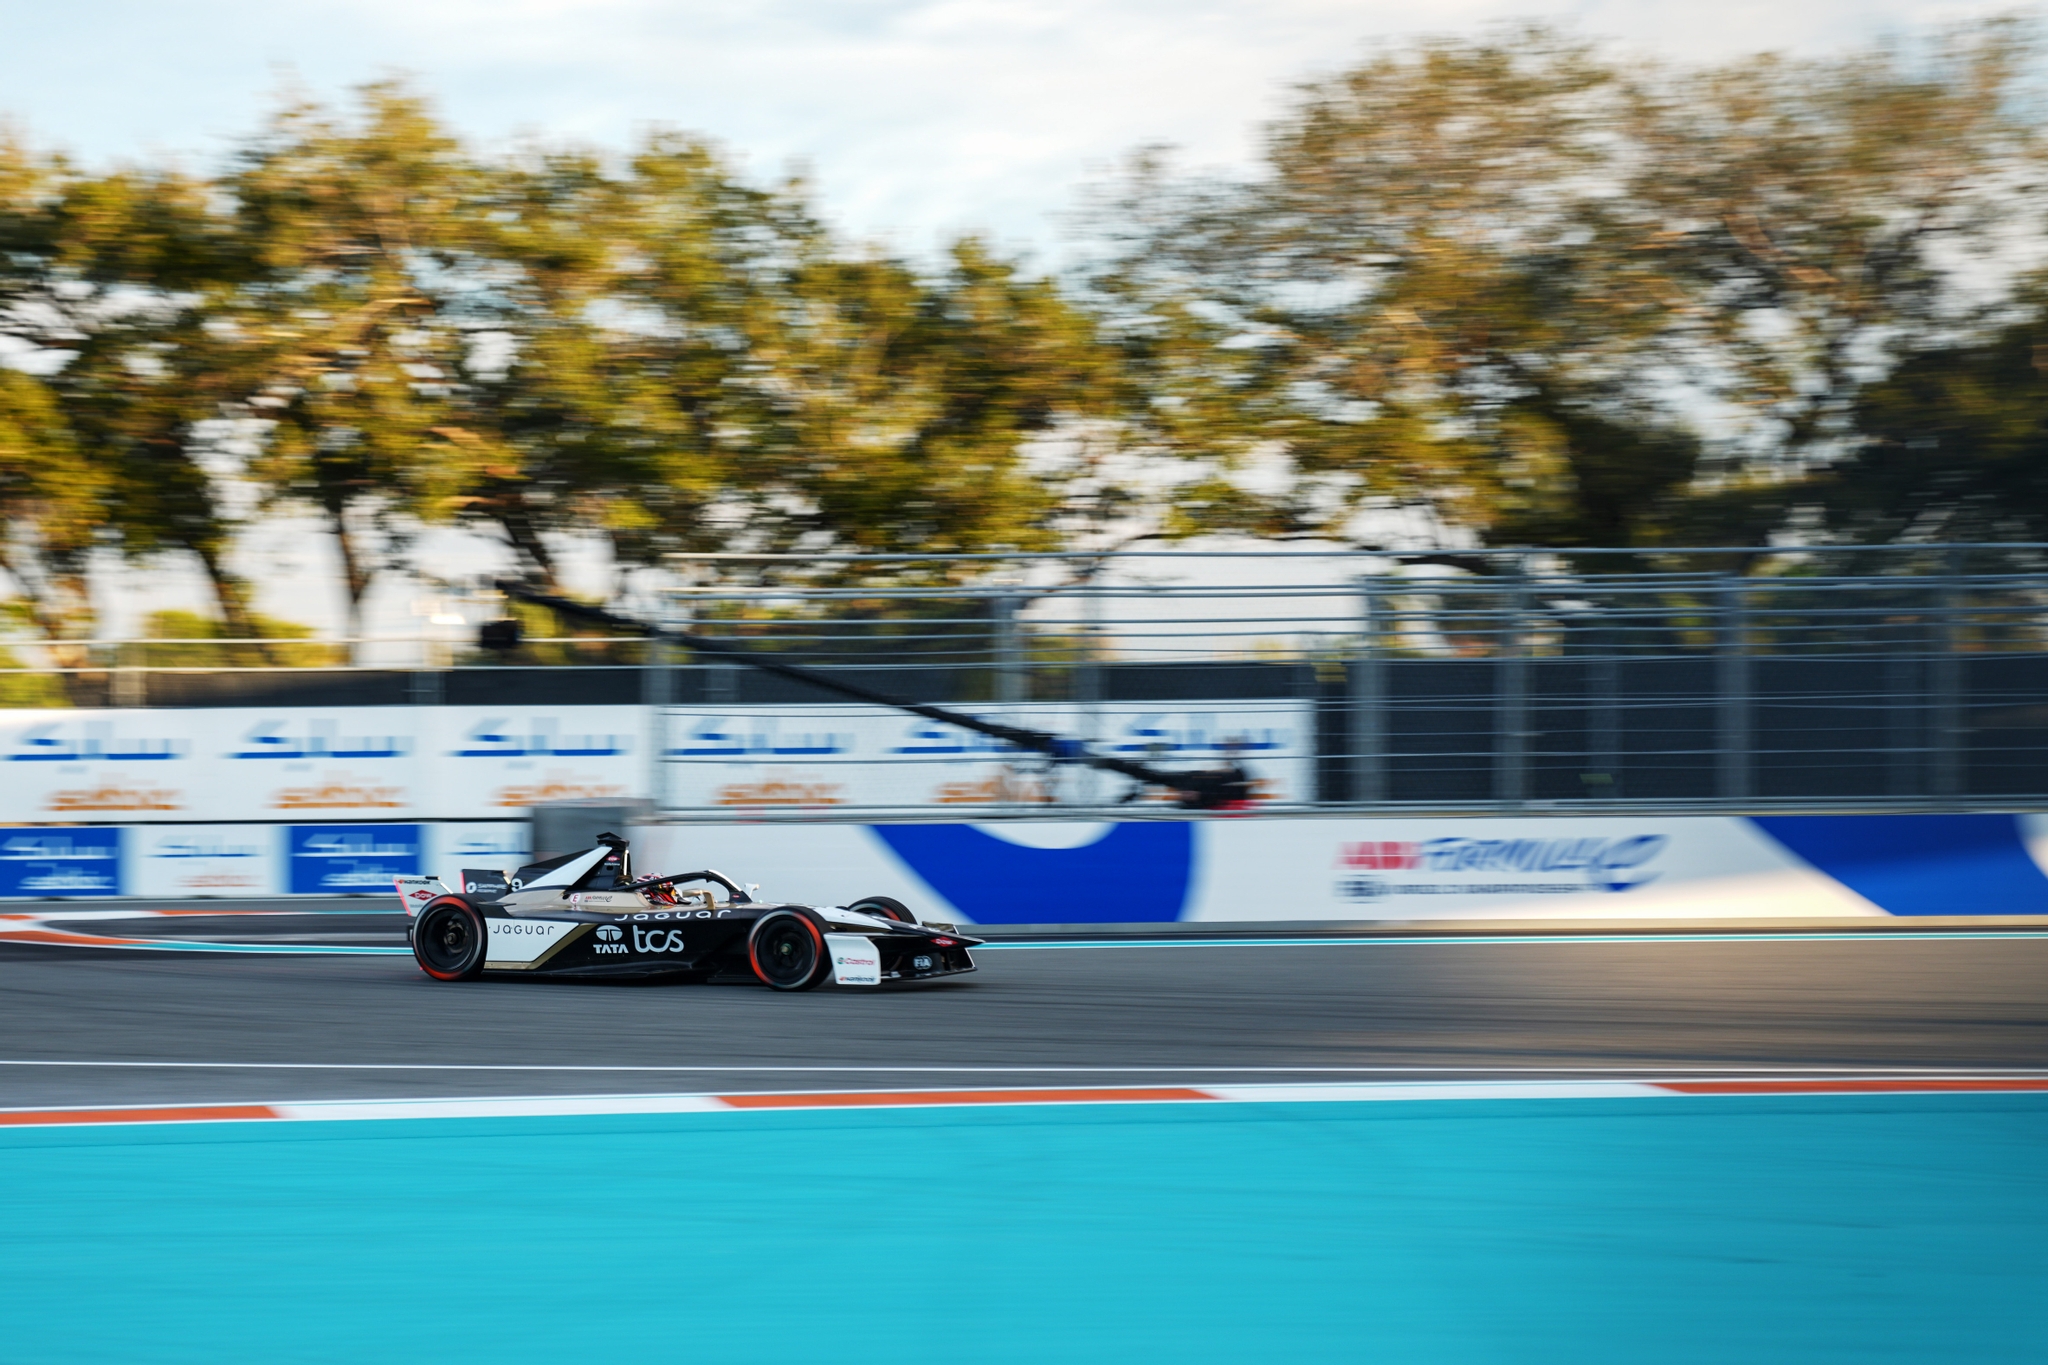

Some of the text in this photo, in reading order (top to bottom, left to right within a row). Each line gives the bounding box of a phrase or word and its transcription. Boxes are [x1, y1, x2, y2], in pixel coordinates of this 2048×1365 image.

[511, 878, 523, 893] 9
[632, 924, 684, 953] tcs
[592, 944, 629, 954] TATA
[914, 957, 932, 968] FIA
